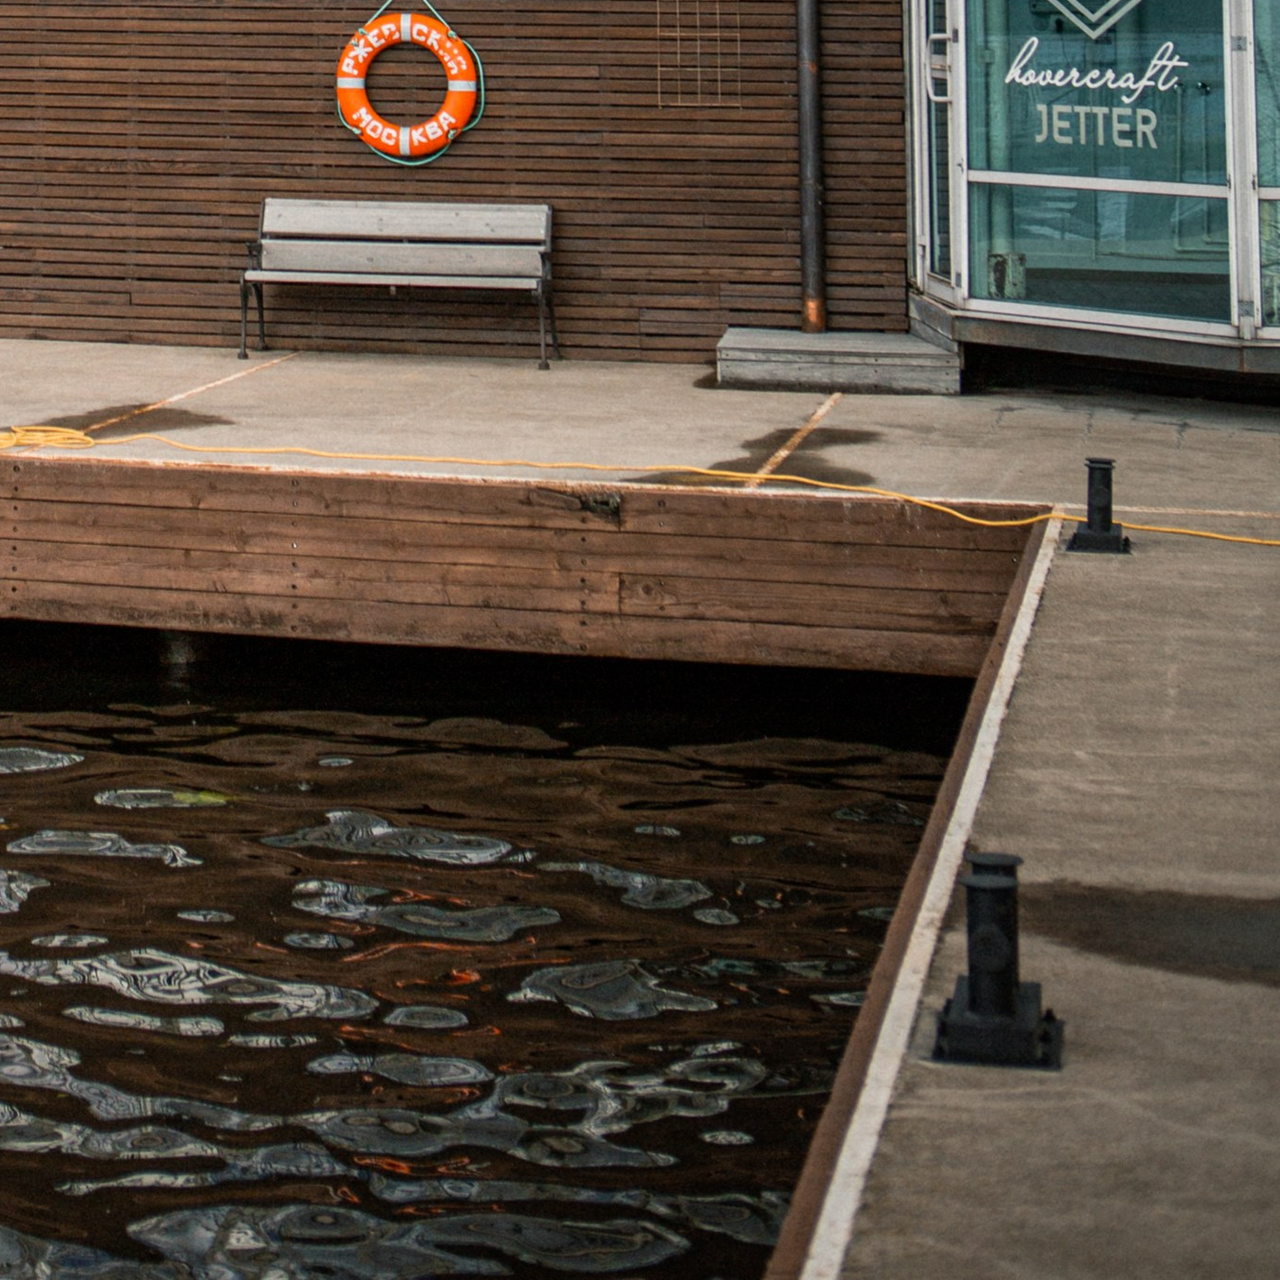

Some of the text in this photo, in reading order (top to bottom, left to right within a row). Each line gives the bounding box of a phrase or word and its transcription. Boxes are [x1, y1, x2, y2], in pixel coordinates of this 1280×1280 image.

[1004, 36, 1189, 104] hovercraft
[352, 107, 456, 146] МОСКВА
[1034, 102, 1158, 149] JETTER
